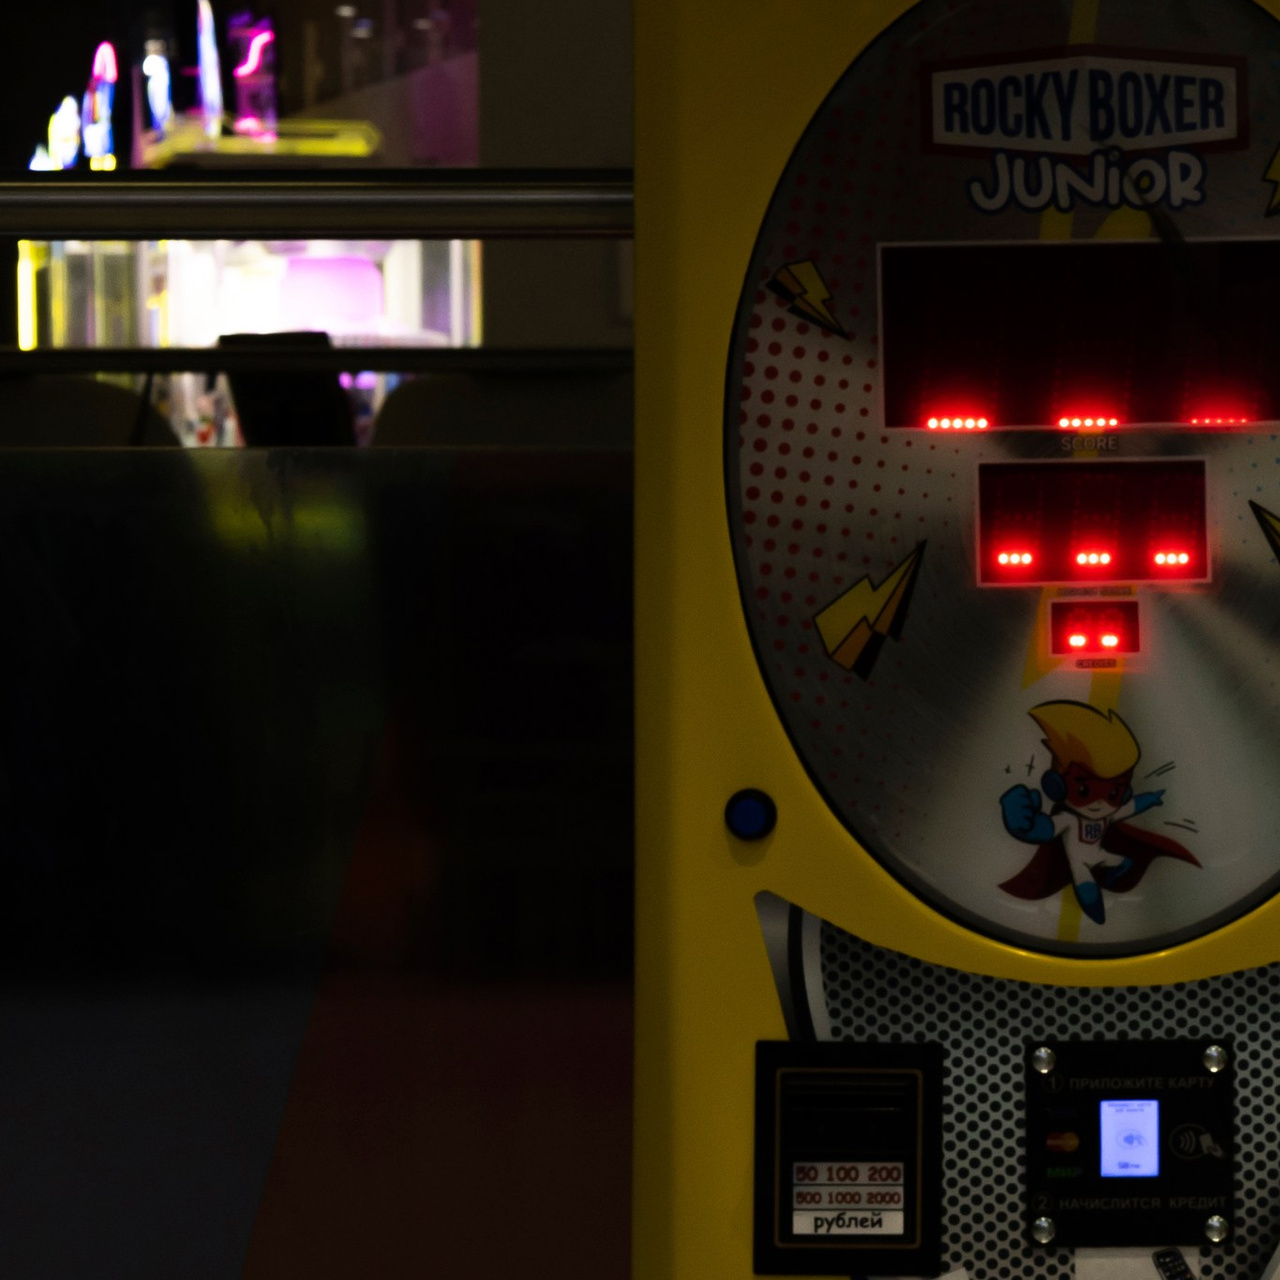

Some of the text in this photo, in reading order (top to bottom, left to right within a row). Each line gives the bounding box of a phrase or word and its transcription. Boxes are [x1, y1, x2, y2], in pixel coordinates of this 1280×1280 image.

[944, 69, 1225, 142] ROCKY BOXER
[1060, 435, 1119, 452] SCORE
[1069, 1076, 1165, 1091] ПРИЛОЖИТЕ
[1168, 1076, 1216, 1090] КАРТУ
[796, 1166, 901, 1182] 50 100 200
[796, 1191, 901, 1205] 500 1000 2000
[1058, 1196, 1161, 1210] НАЧИСЛИТСЯ
[1169, 1196, 1227, 1210] КРЕДИТ
[814, 1212, 882, 1232] рублей
